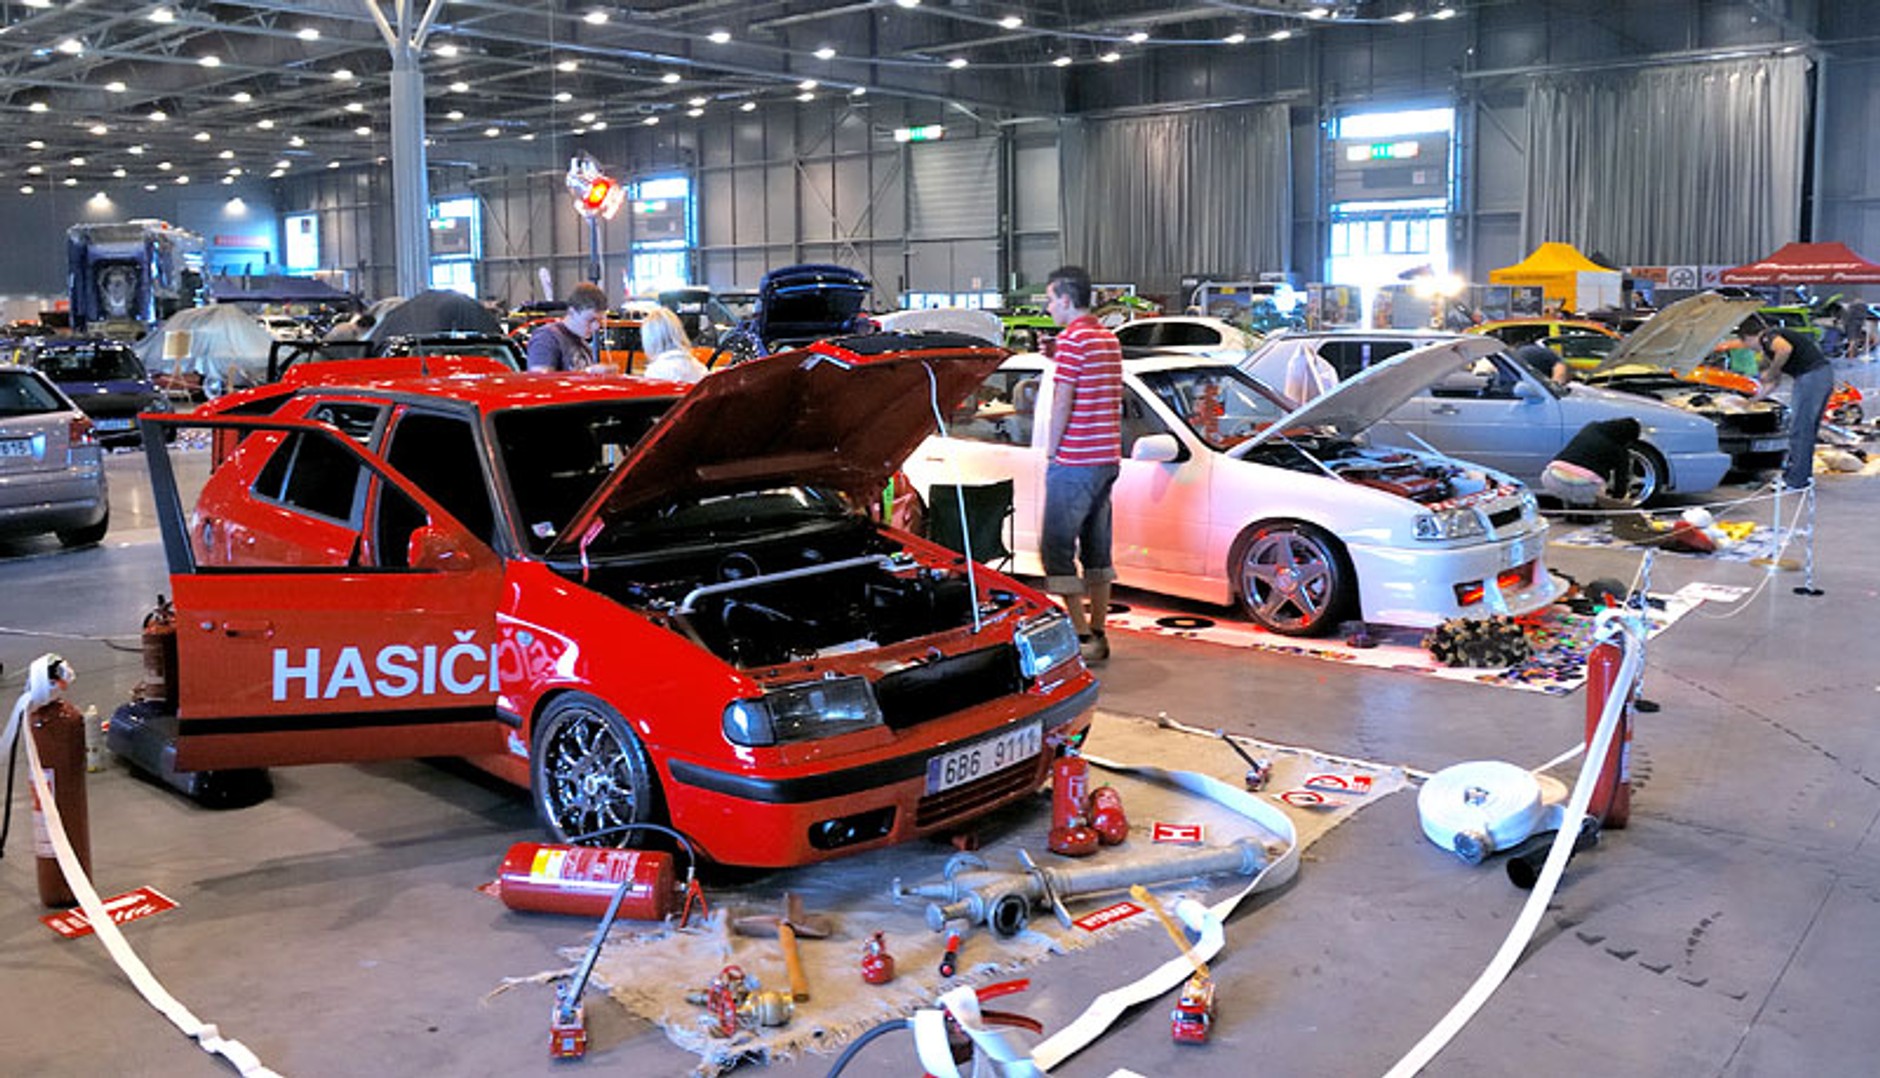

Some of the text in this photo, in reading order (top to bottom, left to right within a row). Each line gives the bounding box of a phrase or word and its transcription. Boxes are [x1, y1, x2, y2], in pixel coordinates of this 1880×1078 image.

[271, 629, 501, 702] HASIČI
[944, 727, 1038, 785] 6B6 9111
